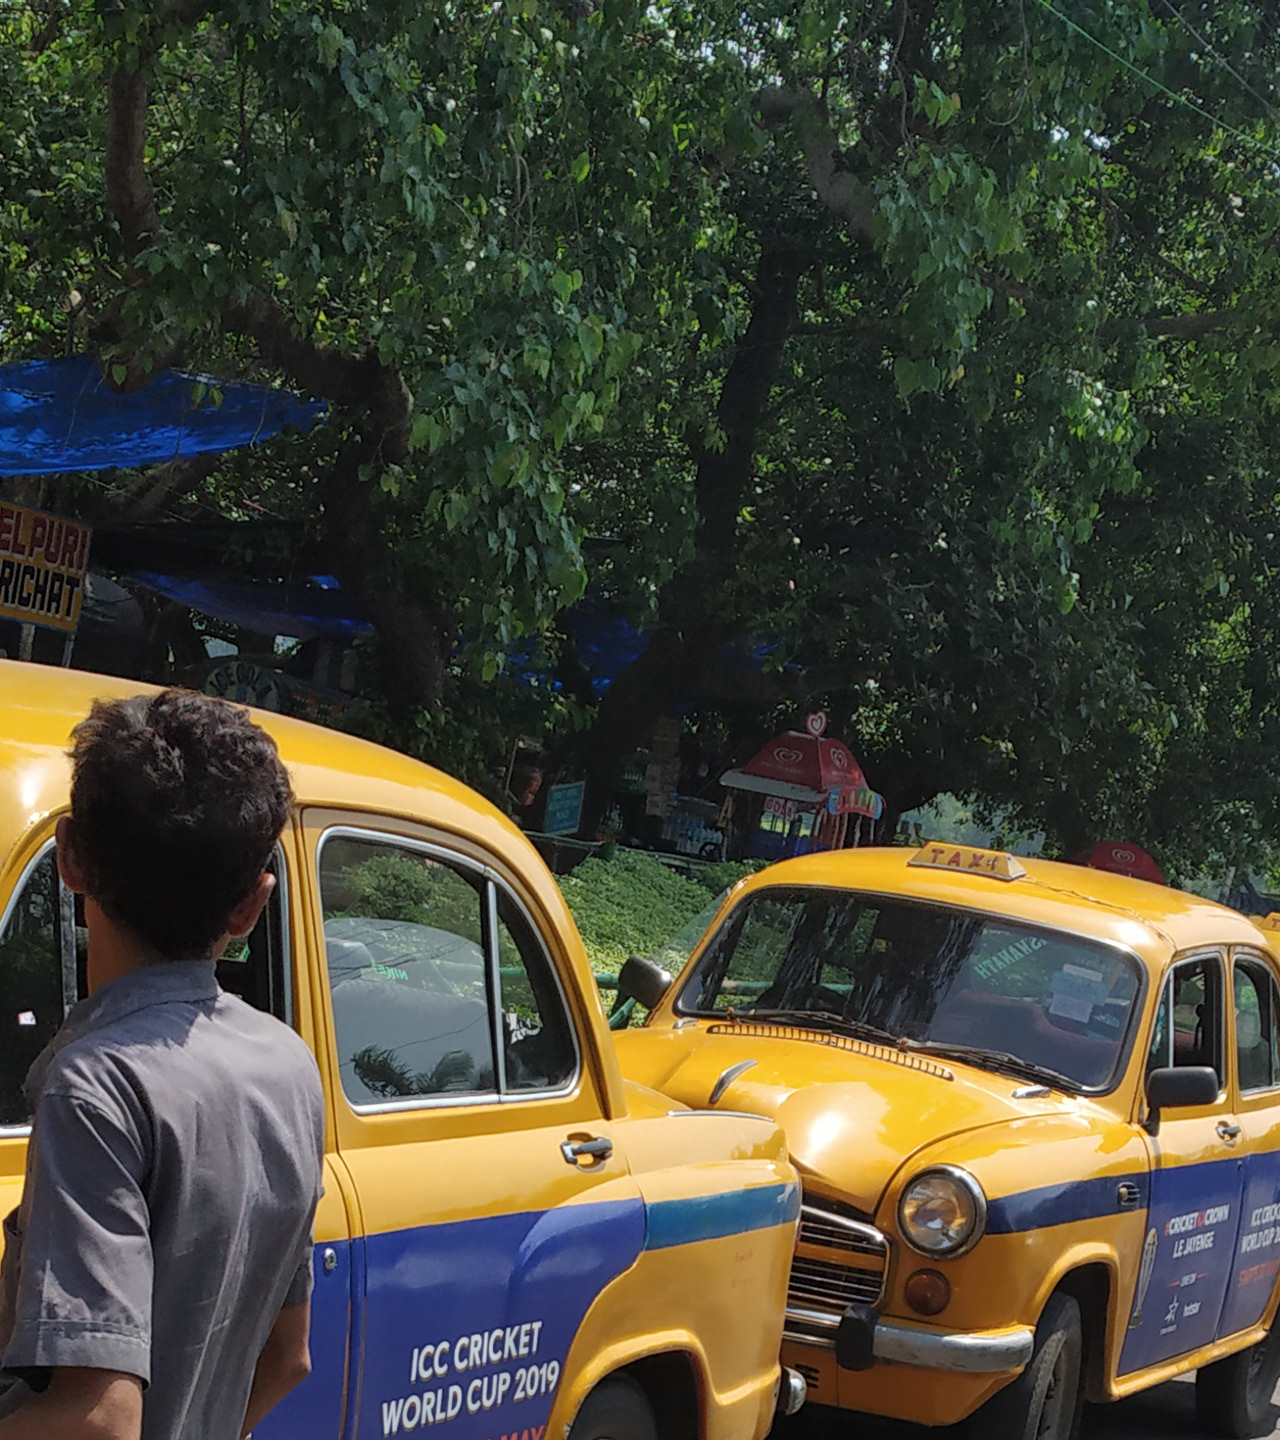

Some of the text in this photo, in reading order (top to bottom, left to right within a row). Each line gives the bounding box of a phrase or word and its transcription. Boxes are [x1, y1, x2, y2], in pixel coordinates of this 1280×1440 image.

[27, 516, 91, 575] PURI
[930, 848, 999, 870] TAXI
[410, 1321, 543, 1384] ICC CRICKET
[382, 1360, 560, 1438] WORLD CUP 2019
